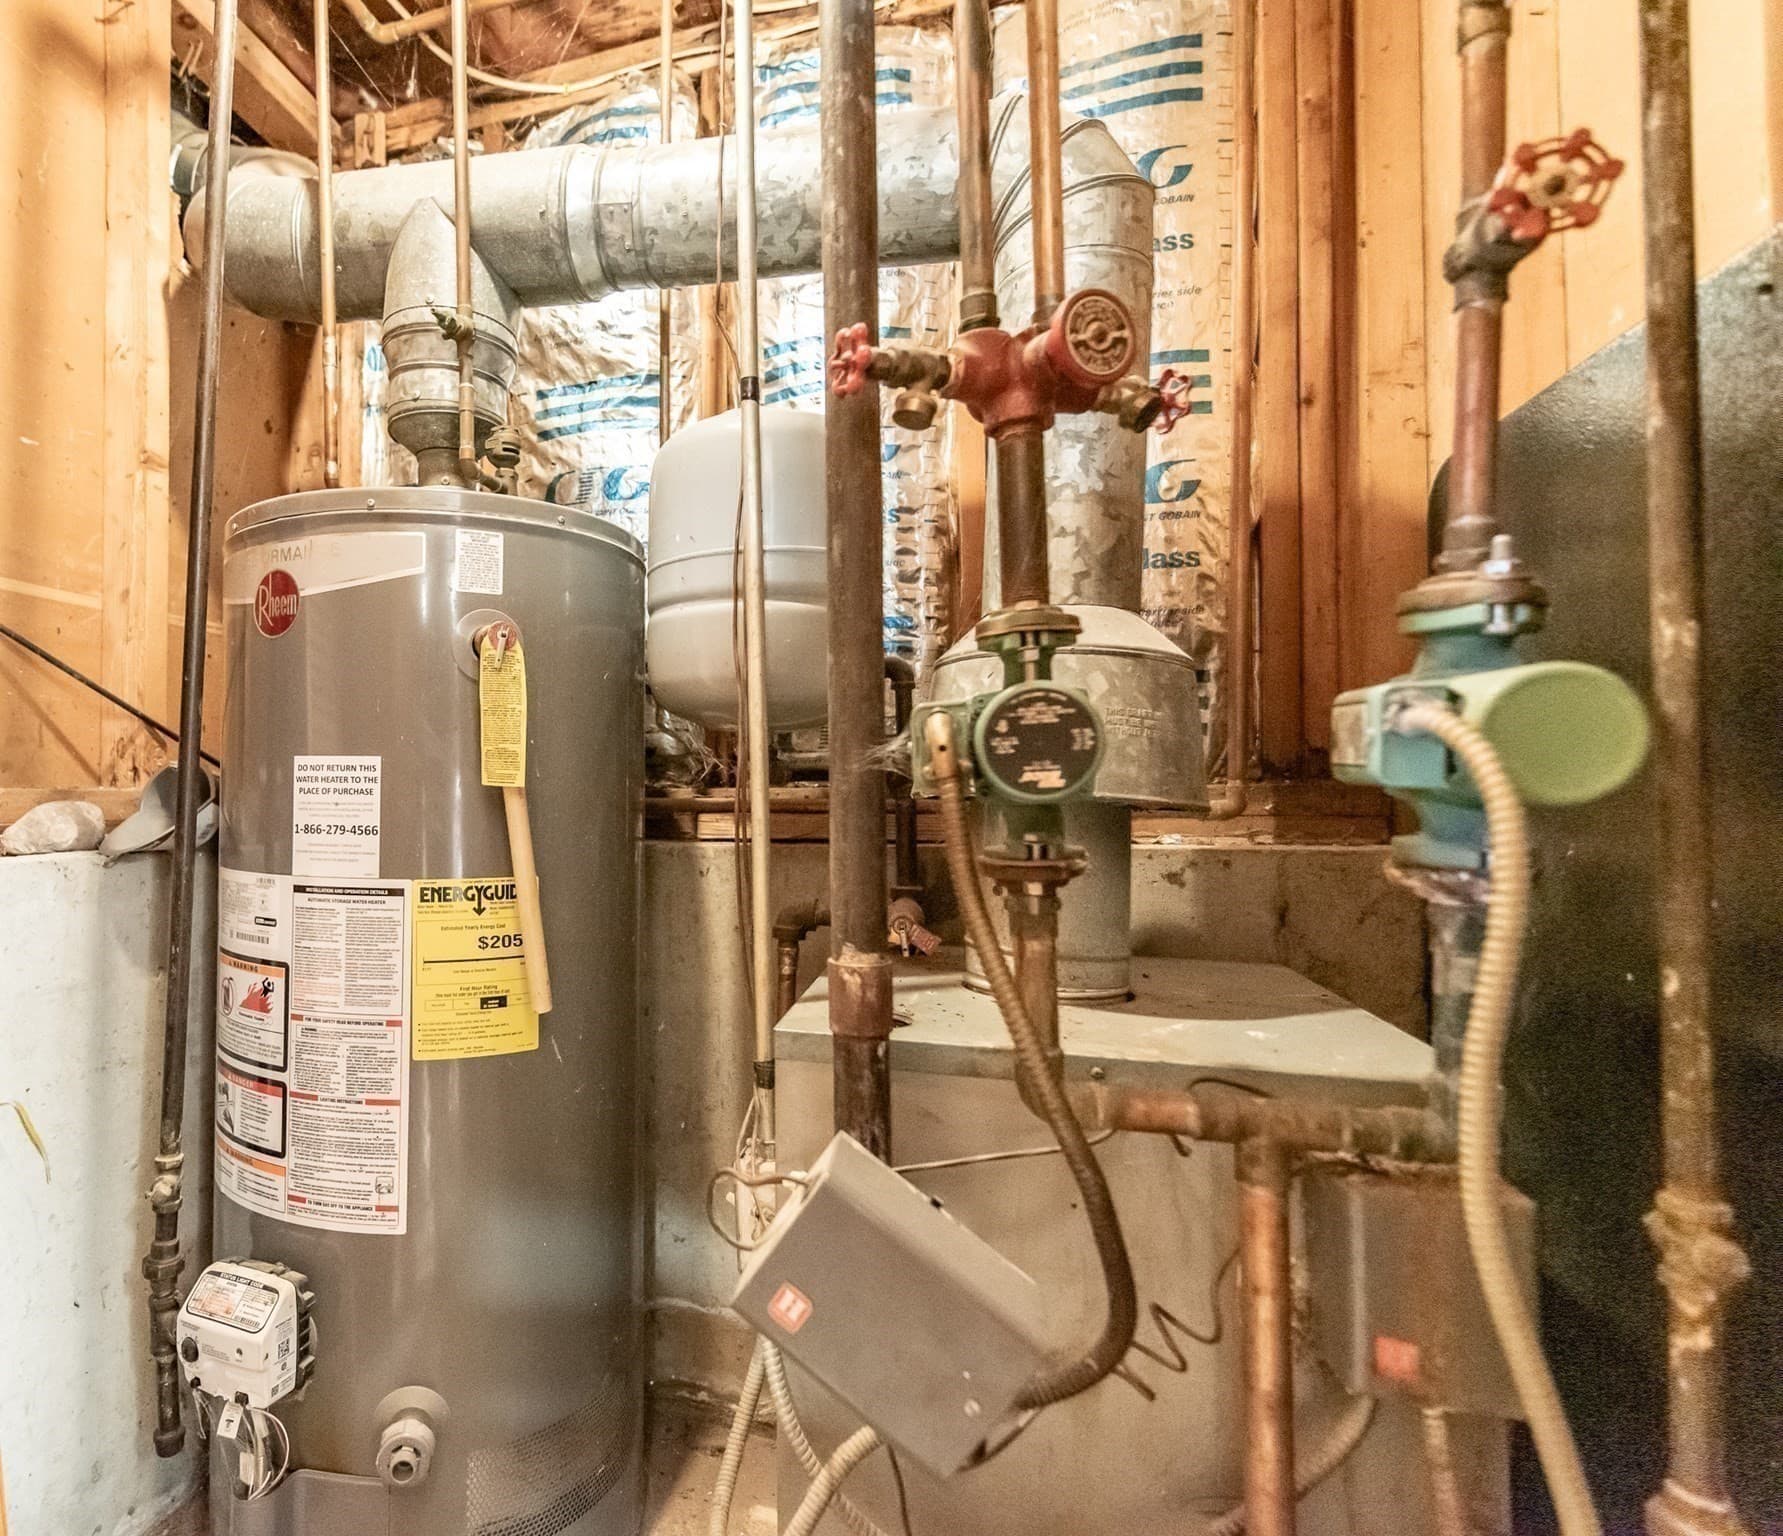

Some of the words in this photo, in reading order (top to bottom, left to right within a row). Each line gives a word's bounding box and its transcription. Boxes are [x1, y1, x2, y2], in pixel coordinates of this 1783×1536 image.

[1158, 510, 1201, 521] GOBAIN
[258, 572, 298, 627] Rheem
[297, 764, 308, 772] DO
[309, 764, 325, 772] NOT
[326, 764, 357, 772] RETURN
[359, 764, 377, 772] THIS
[296, 775, 319, 783] WATER
[321, 775, 349, 783] HEATER
[350, 776, 362, 784] TO
[363, 776, 379, 784] THE
[298, 787, 320, 795] PLACE
[321, 787, 332, 795] OF
[332, 788, 375, 796] PURCHASE
[294, 823, 379, 836] 1-866-279-4566
[419, 884, 517, 903] ENERGYGUID
[478, 933, 524, 951] $205
